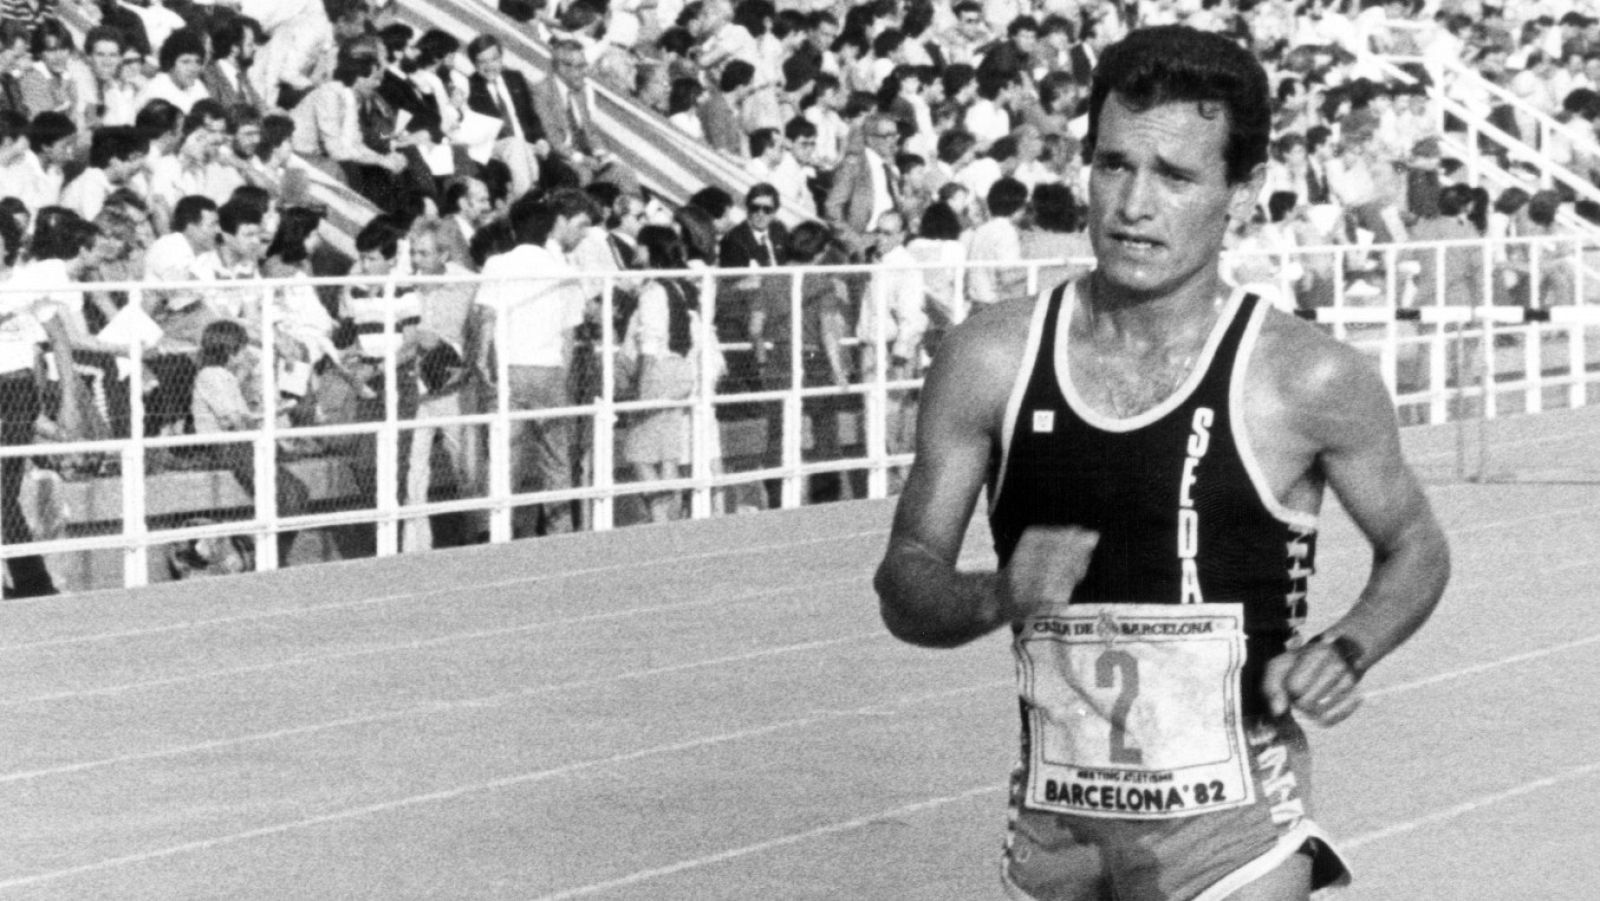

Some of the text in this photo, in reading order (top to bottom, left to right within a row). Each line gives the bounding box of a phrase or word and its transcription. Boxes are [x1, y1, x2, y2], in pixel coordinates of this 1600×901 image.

[1178, 406, 1214, 604] SEDA
[1074, 623, 1094, 636] DE
[1121, 620, 1213, 636] BARCELONA
[1095, 650, 1143, 765] 2
